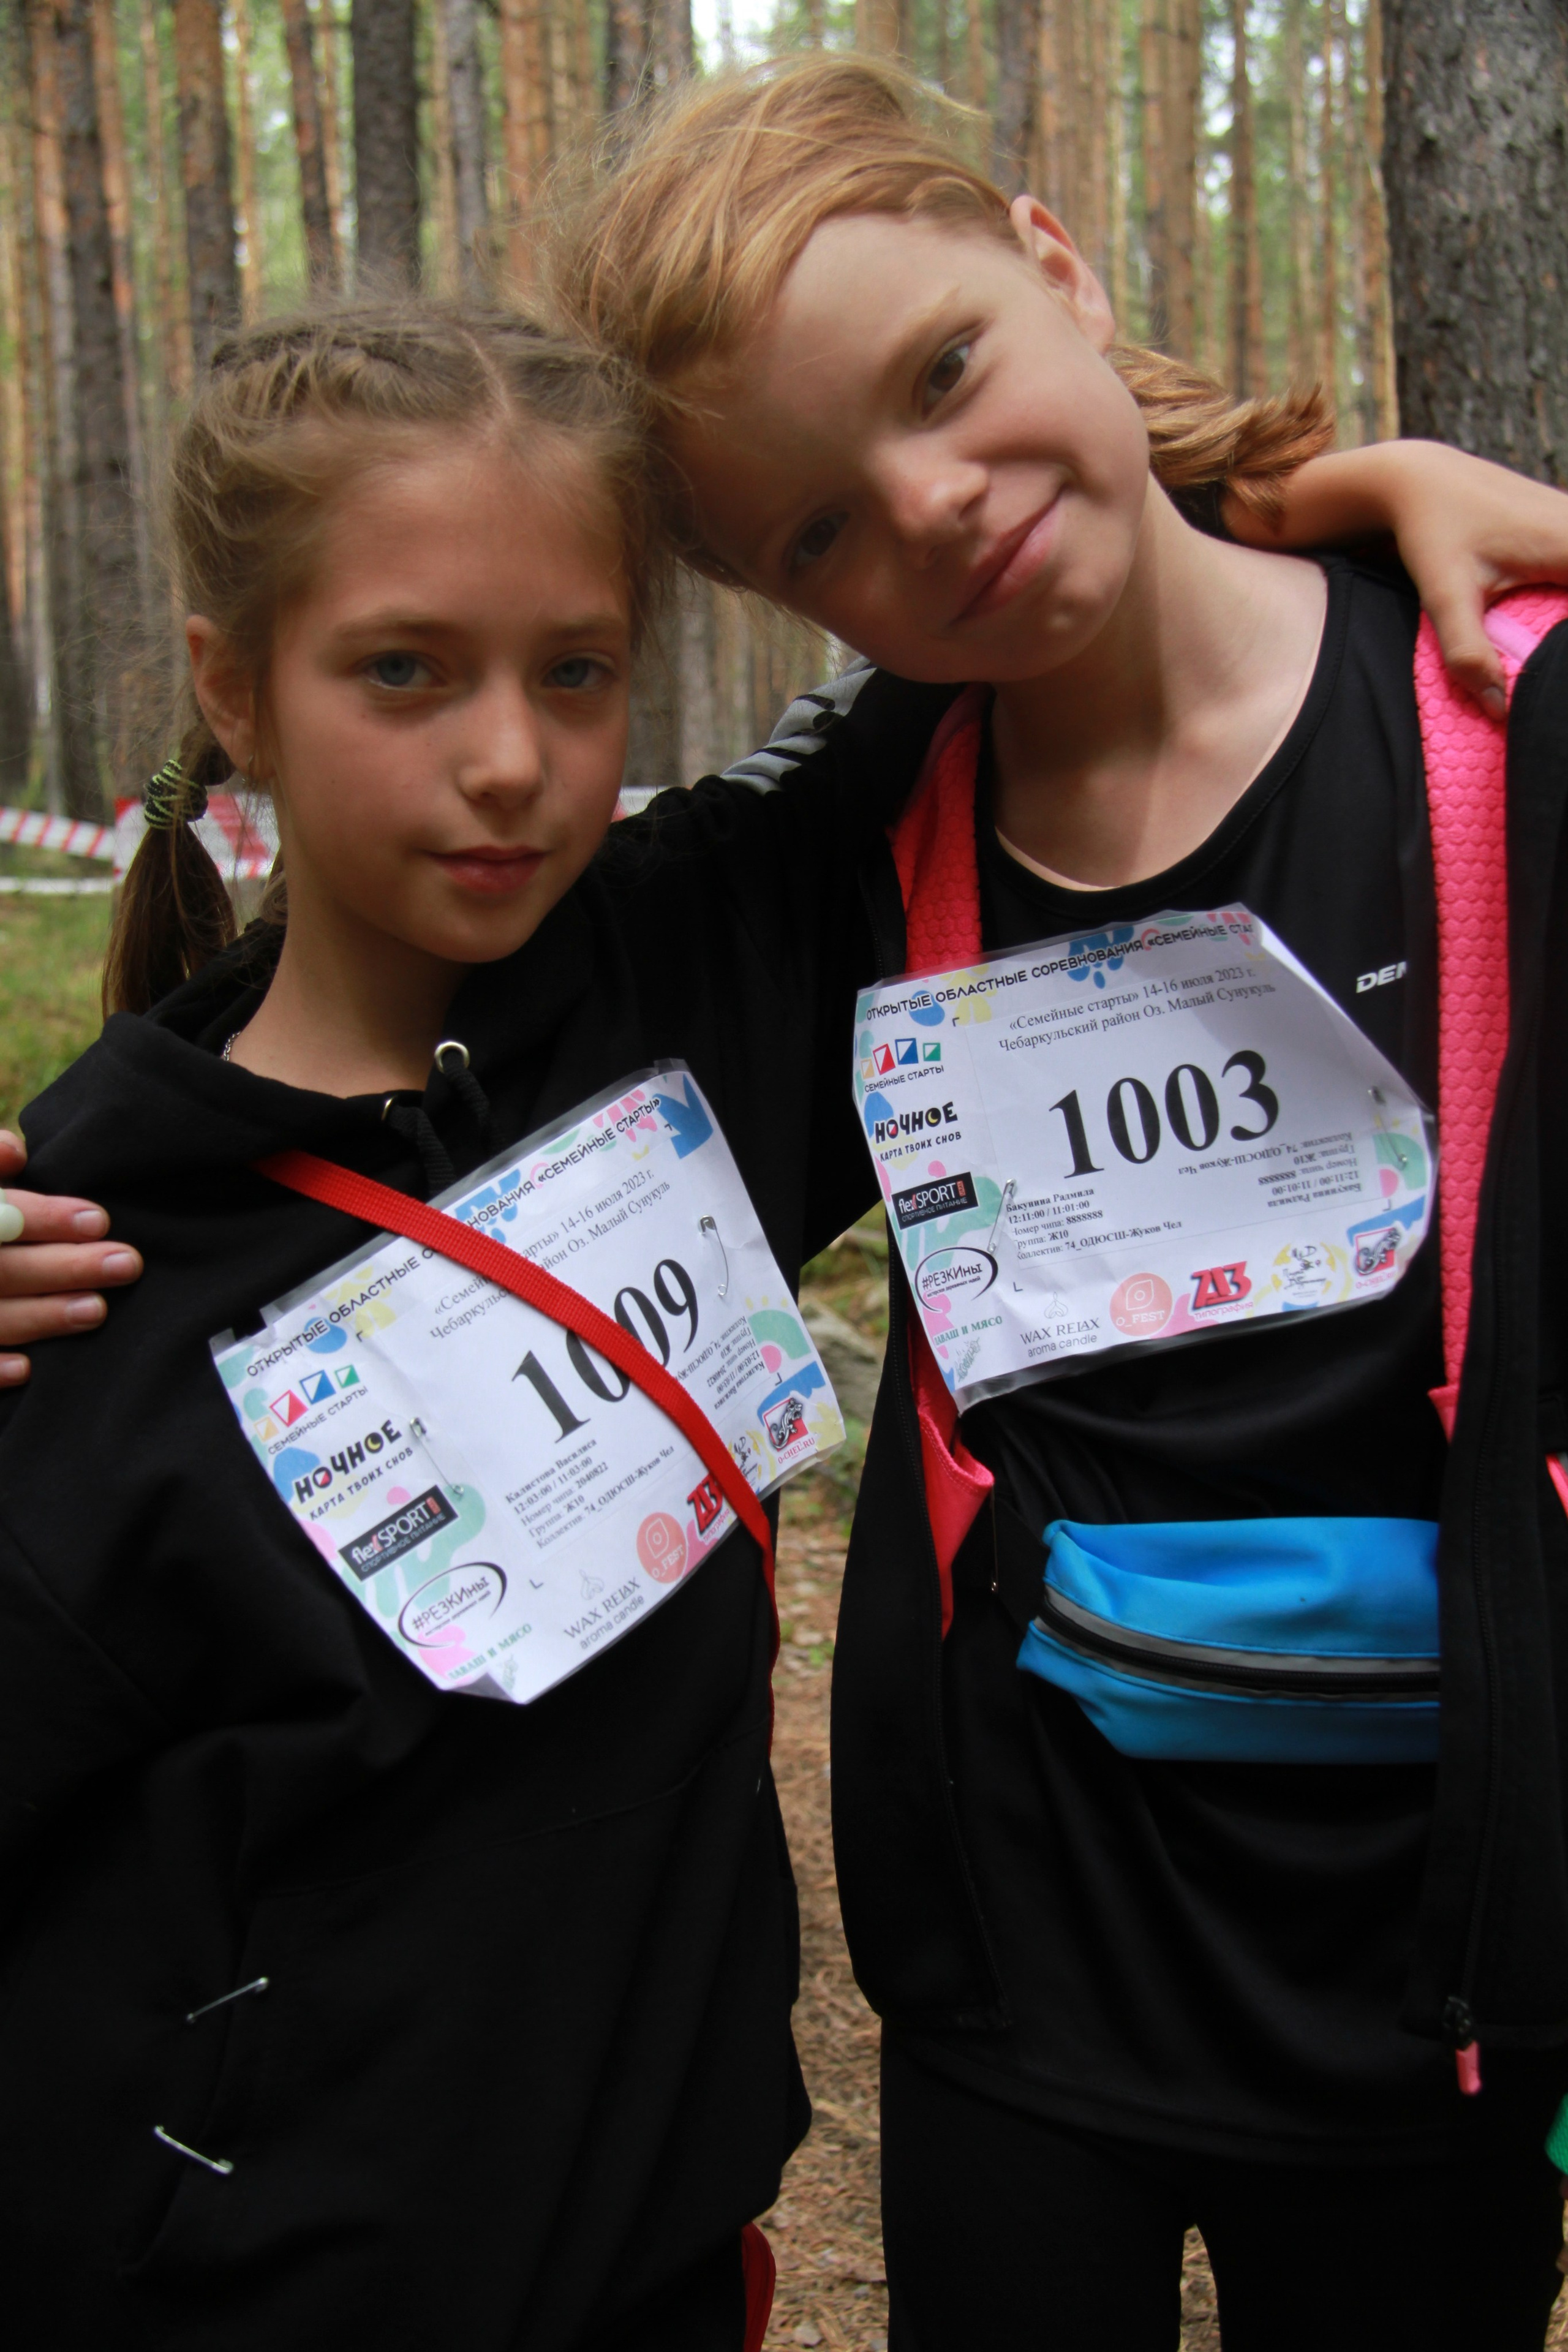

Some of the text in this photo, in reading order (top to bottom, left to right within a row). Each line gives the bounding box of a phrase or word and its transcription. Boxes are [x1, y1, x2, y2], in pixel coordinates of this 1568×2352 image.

[864, 994, 932, 1021] ОТКРЫТЫЕ
[935, 970, 1028, 1003] ОБЛАСТНЫЕ
[1031, 939, 1144, 978] СОРЕВНОВАНИЯ
[1147, 925, 1227, 946] «СЕМЕЙНЫЕ
[998, 984, 1276, 1051] Чебаркульский район Оз. Малый Сунукуль
[1009, 967, 1256, 1030] «Семейные старты» 14-16 июля 2023 г.
[864, 1065, 944, 1093] СЕМЕЙНЫЕ СТАРТЫ
[875, 1101, 958, 1144] НОЧНОЕ
[1049, 1049, 1280, 1178] 1003
[880, 1131, 962, 1161] КАРТА ТВОИХ СНОВ
[560, 1206, 594, 1233] 14-16
[594, 1189, 624, 1213] июля
[622, 1170, 646, 1194] 2023
[646, 1169, 654, 1179] г.
[1005, 1188, 1095, 1213] Бакунина Радмила
[1272, 1180, 1311, 1196] 11:01:00
[1319, 1170, 1359, 1185] 12:11:00
[567, 1238, 589, 1253] Оз.
[587, 1208, 628, 1240] Малый
[627, 1182, 670, 1214] Сунукуль
[1008, 1209, 1045, 1224] 12:11:00
[1052, 1200, 1090, 1215] 11:01:00
[1041, 1219, 1065, 1230] чипа:
[1065, 1210, 1103, 1224] 8888888
[1047, 1229, 1069, 1241] Ж10
[1163, 1221, 1182, 1230] Чел
[247, 1320, 328, 1376] ОТКРЫТЫЕ
[328, 1256, 420, 1326] ОБЛАСТНЫЕ
[538, 1127, 616, 1182] «СЕМЕЙНЫЕ
[616, 1097, 660, 1133] СТАРТЫ»
[961, 1325, 968, 1335] И
[971, 1315, 1003, 1332] МЯСО
[1019, 1317, 1100, 1345] WAX RELAX
[1027, 1333, 1098, 1358] aroma candle
[512, 1258, 697, 1443] 1009
[268, 1386, 368, 1455] СЕМЕЙНЫЕ СТАРТЫ
[295, 1419, 402, 1503] НОЧНОЕ
[505, 1439, 597, 1504] Калистова Василиса
[659, 1446, 674, 1458] Чел
[309, 1447, 413, 1520] КАРТА ТВОИХ СНОВ
[514, 1484, 552, 1514] 12:03:00
[557, 1457, 592, 1484] 11:03:00
[520, 1461, 608, 1526] Номер чипа: 2040822
[528, 1494, 584, 1537] Группа: Ж10
[563, 1577, 640, 1638] WAX RELAX
[579, 1595, 644, 1649] aroma candle
[498, 1623, 532, 1648] МЯСО
